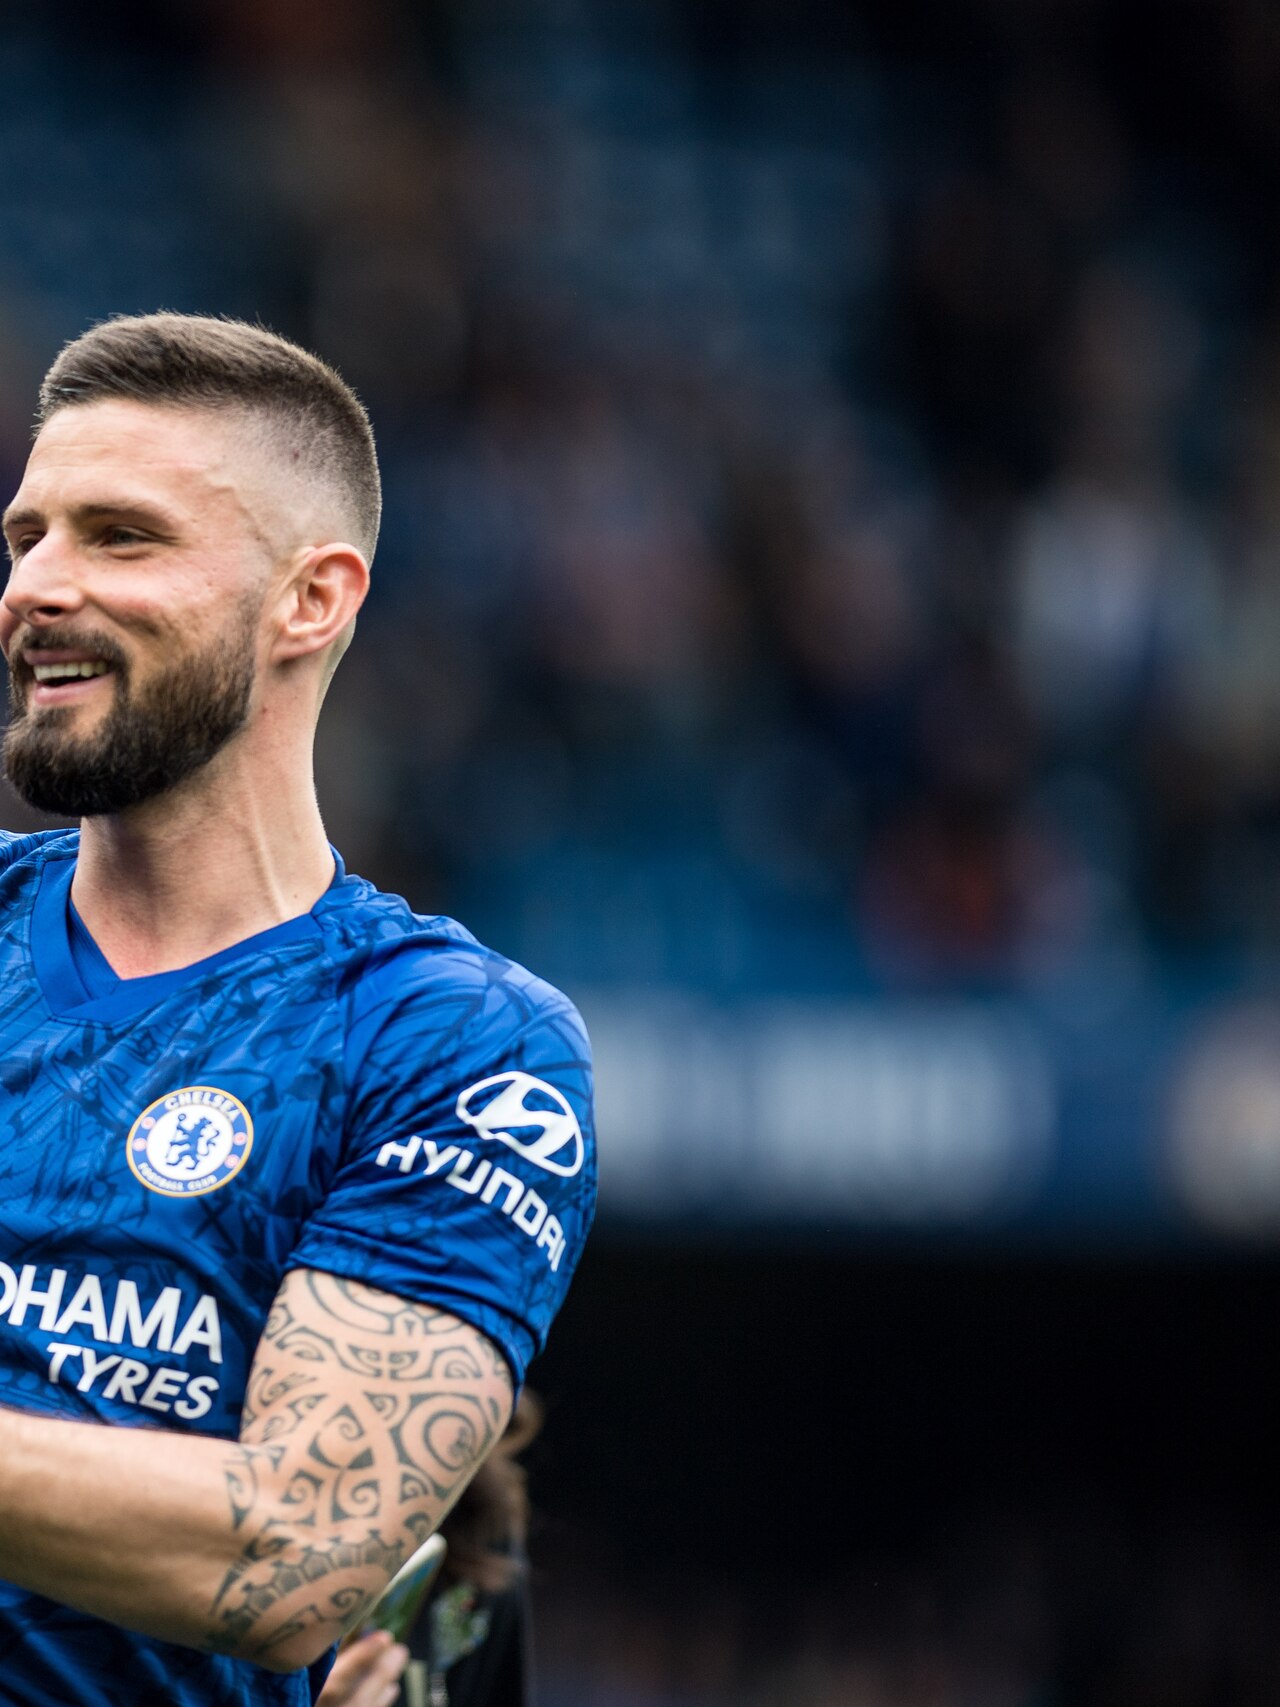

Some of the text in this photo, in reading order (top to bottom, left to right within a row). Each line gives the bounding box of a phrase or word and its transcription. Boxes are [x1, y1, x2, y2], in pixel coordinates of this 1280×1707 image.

[164, 1090, 241, 1122] CHELSEA
[375, 1135, 567, 1273] HYUNDAI
[46, 1342, 219, 1421] TYRES
